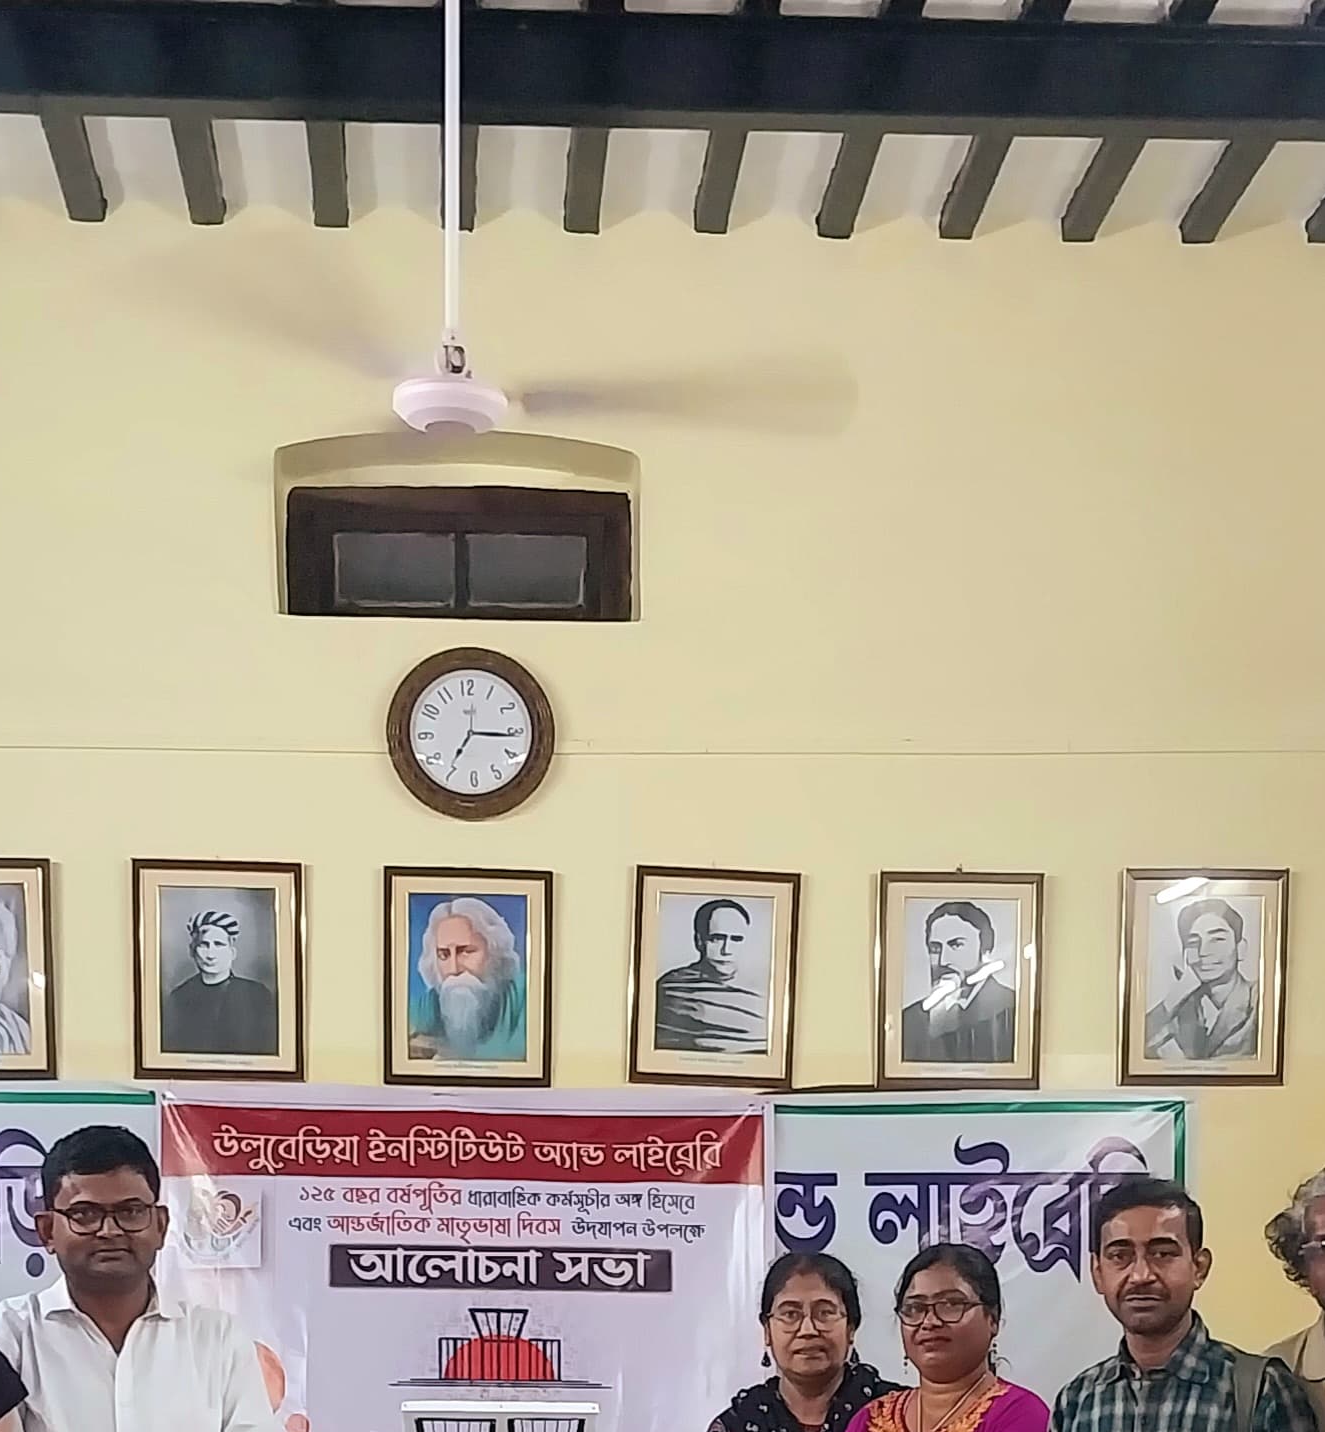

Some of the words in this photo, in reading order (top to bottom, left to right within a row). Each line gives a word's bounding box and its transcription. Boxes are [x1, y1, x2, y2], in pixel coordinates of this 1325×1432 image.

[460, 679, 475, 696] 12
[486, 685, 494, 700] 1
[421, 704, 440, 720] 10
[500, 702, 516, 714] 2
[418, 731, 434, 740] 9
[446, 764, 457, 782] 7
[470, 771, 478, 788] 6
[490, 764, 502, 780] 5
[211, 1124, 360, 1174] উলুবেড়িয়া
[366, 1126, 526, 1168] ইনস্টিটিউট
[532, 1140, 606, 1172] অ্যান্ড
[613, 1131, 723, 1175] লাইব্রেরি
[299, 1185, 336, 1202] ১২৫
[341, 1187, 380, 1204] বছর
[468, 1185, 542, 1208] ধারাবাহিক
[545, 1188, 611, 1215] কর্মসূচীর
[613, 1193, 643, 1208] অঙ্গ
[647, 1187, 695, 1215] হিসেবে
[288, 1216, 322, 1233] এবং
[327, 1209, 432, 1236] আন্তর্জাতিক
[437, 1216, 511, 1244] মাতৃভাষা
[517, 1211, 562, 1238] দিবস
[642, 1218, 706, 1243] উপলক্ষে
[347, 1248, 543, 1285] আলোচনা
[552, 1250, 651, 1287] সভা
